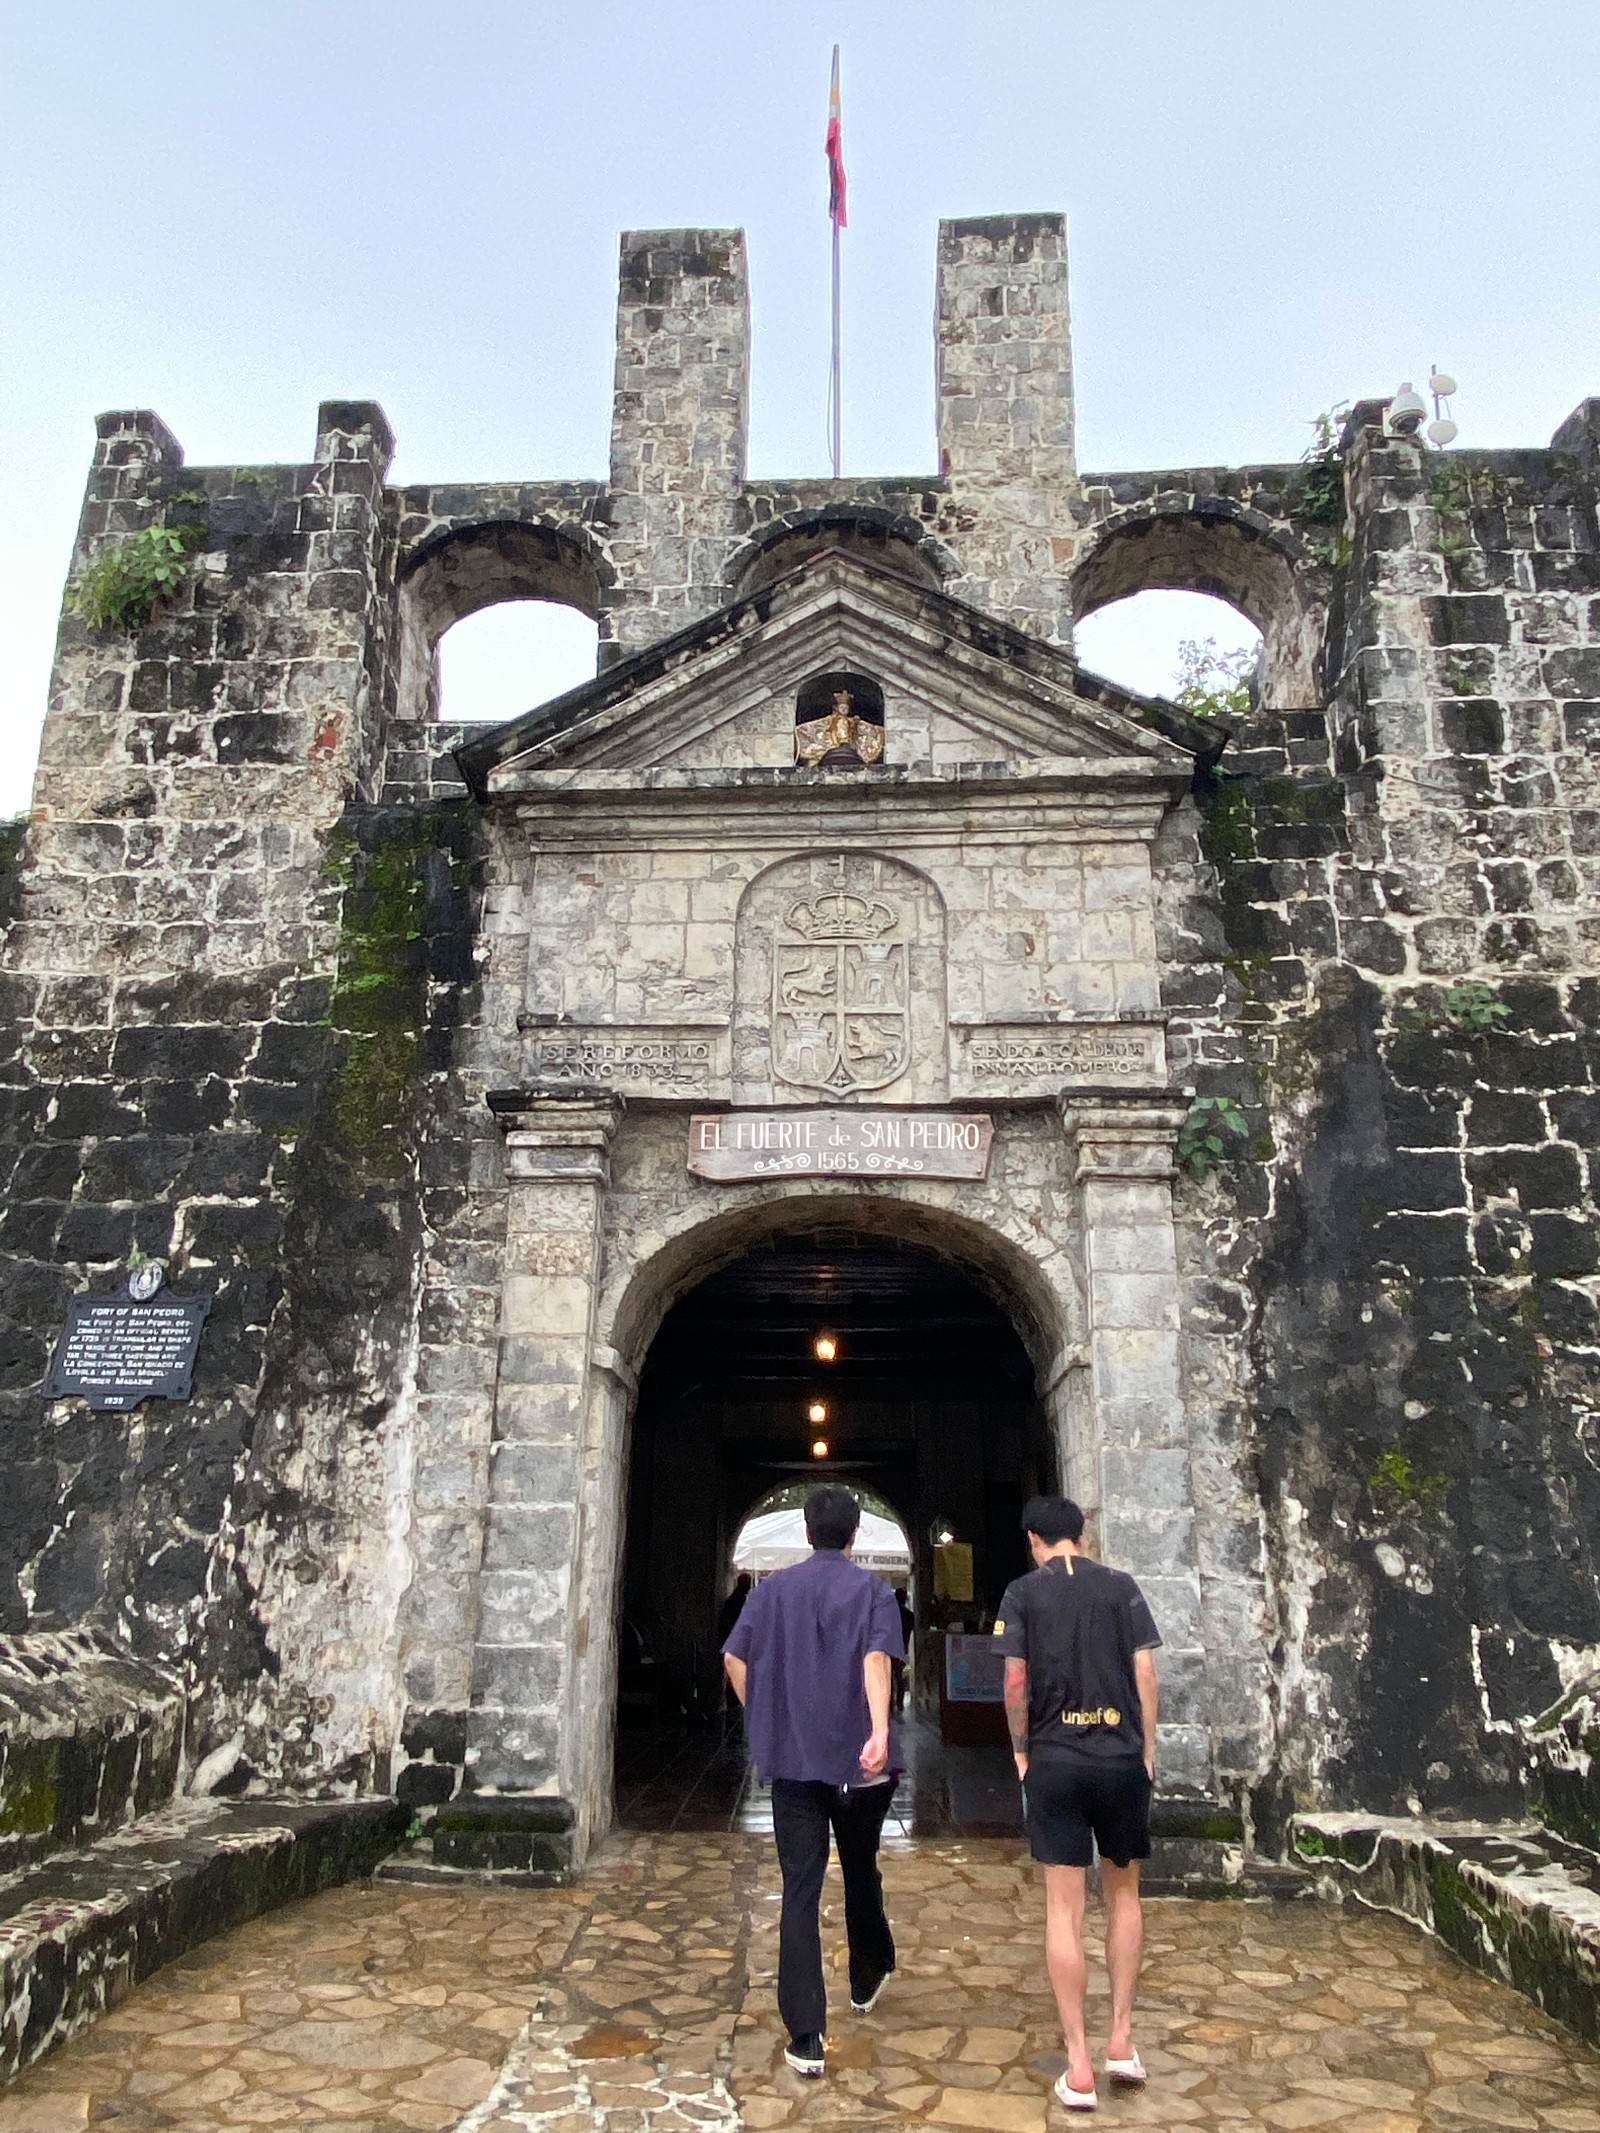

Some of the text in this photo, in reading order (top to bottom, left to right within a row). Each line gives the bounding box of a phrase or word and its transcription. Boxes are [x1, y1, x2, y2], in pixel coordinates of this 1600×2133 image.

[700, 1120, 981, 1150] EL FUERTE de SAN PEDRO
[817, 1151, 860, 1171] 1565
[91, 1307, 185, 1317] FORT OF SAN PEDRO
[1062, 1706, 1103, 1725] unicef
